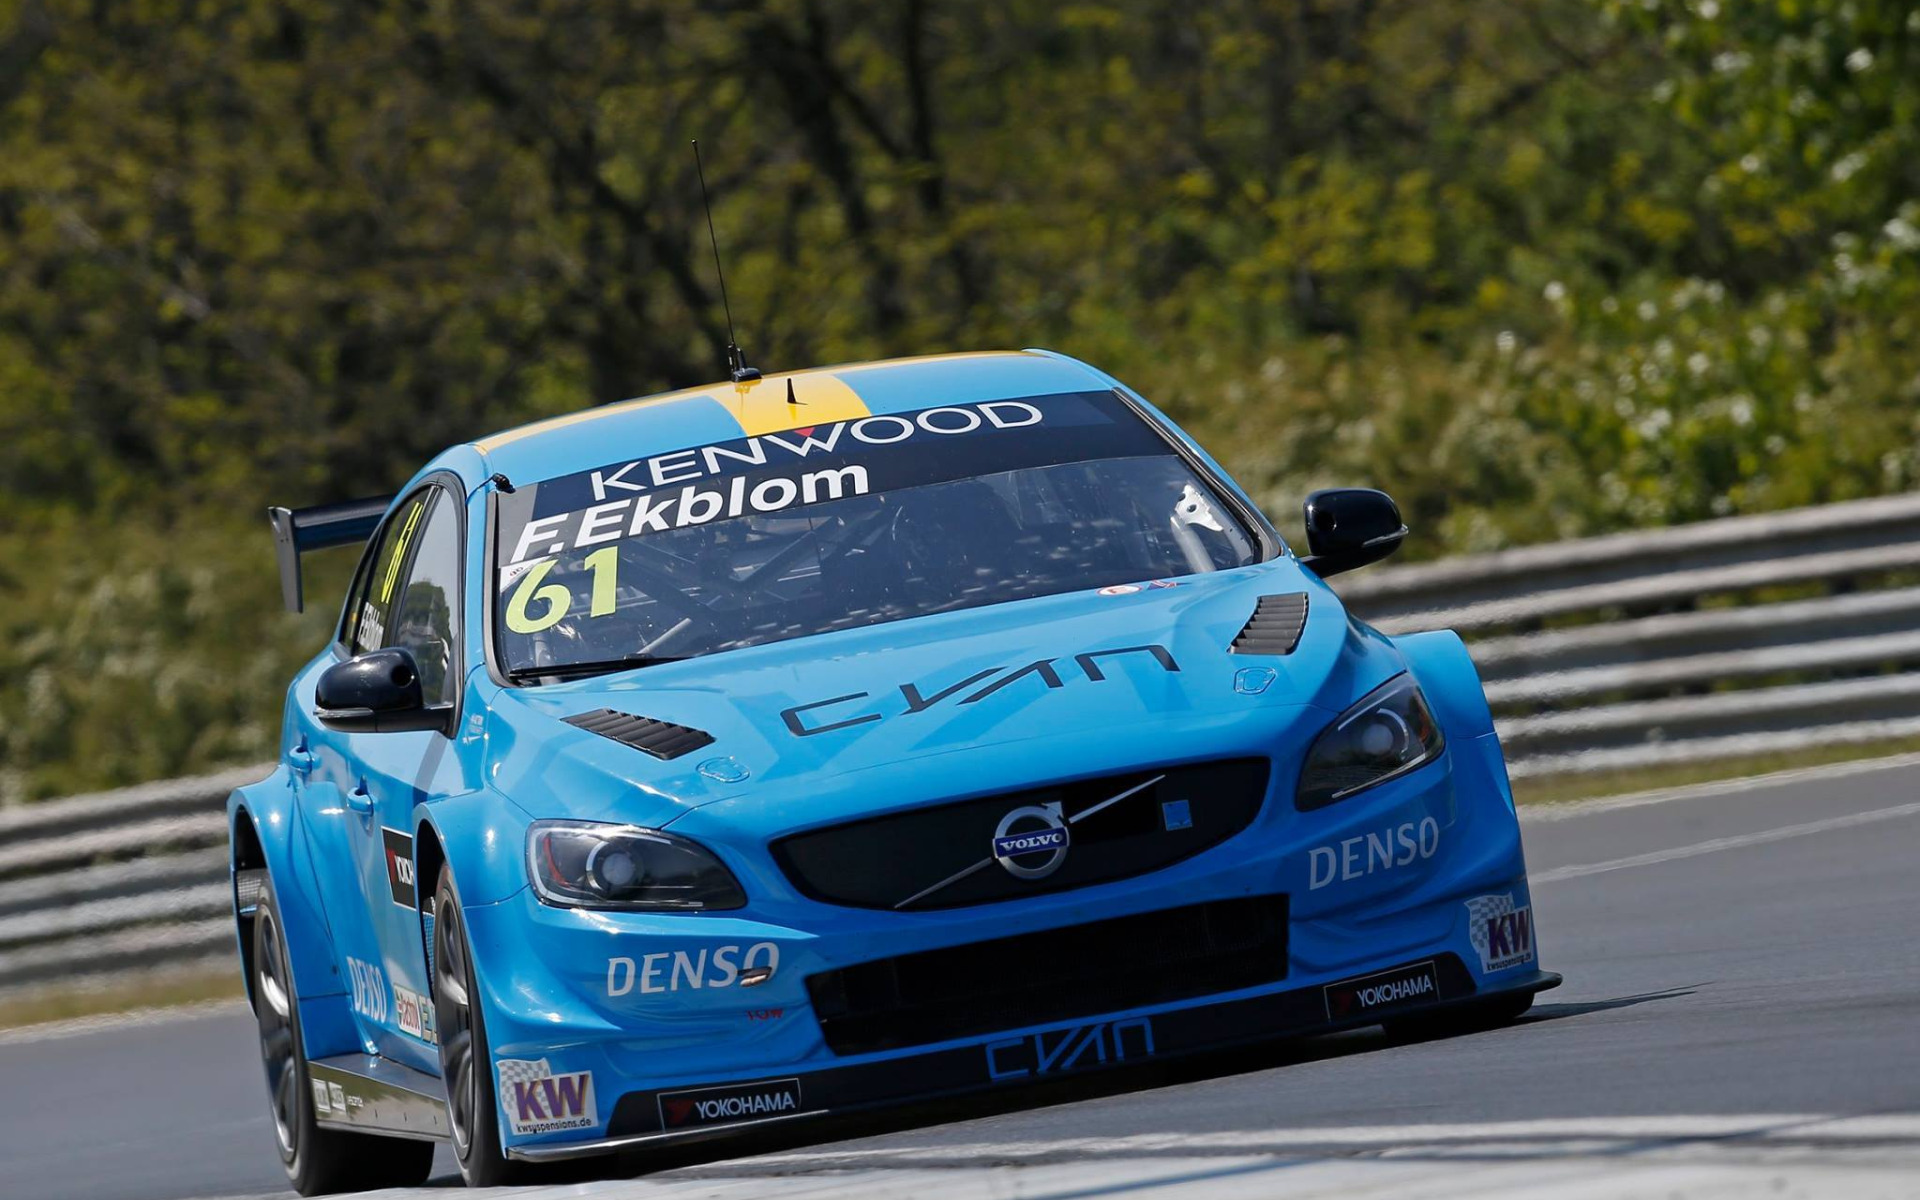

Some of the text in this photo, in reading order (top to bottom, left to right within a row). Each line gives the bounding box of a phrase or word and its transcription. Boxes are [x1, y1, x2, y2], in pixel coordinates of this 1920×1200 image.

[591, 401, 1043, 501] KENWOOD
[509, 462, 870, 564] F.Ekblom
[505, 545, 618, 634] 61
[999, 831, 1064, 851] VOLVO
[1308, 816, 1439, 890] DENSO
[1486, 908, 1531, 960] KW
[346, 955, 388, 1024] DENSO
[607, 942, 780, 997] DENSO
[1356, 975, 1434, 1008] YOKOHAMA
[513, 1073, 590, 1122] KW
[695, 1091, 796, 1120] YOKOHAMA
